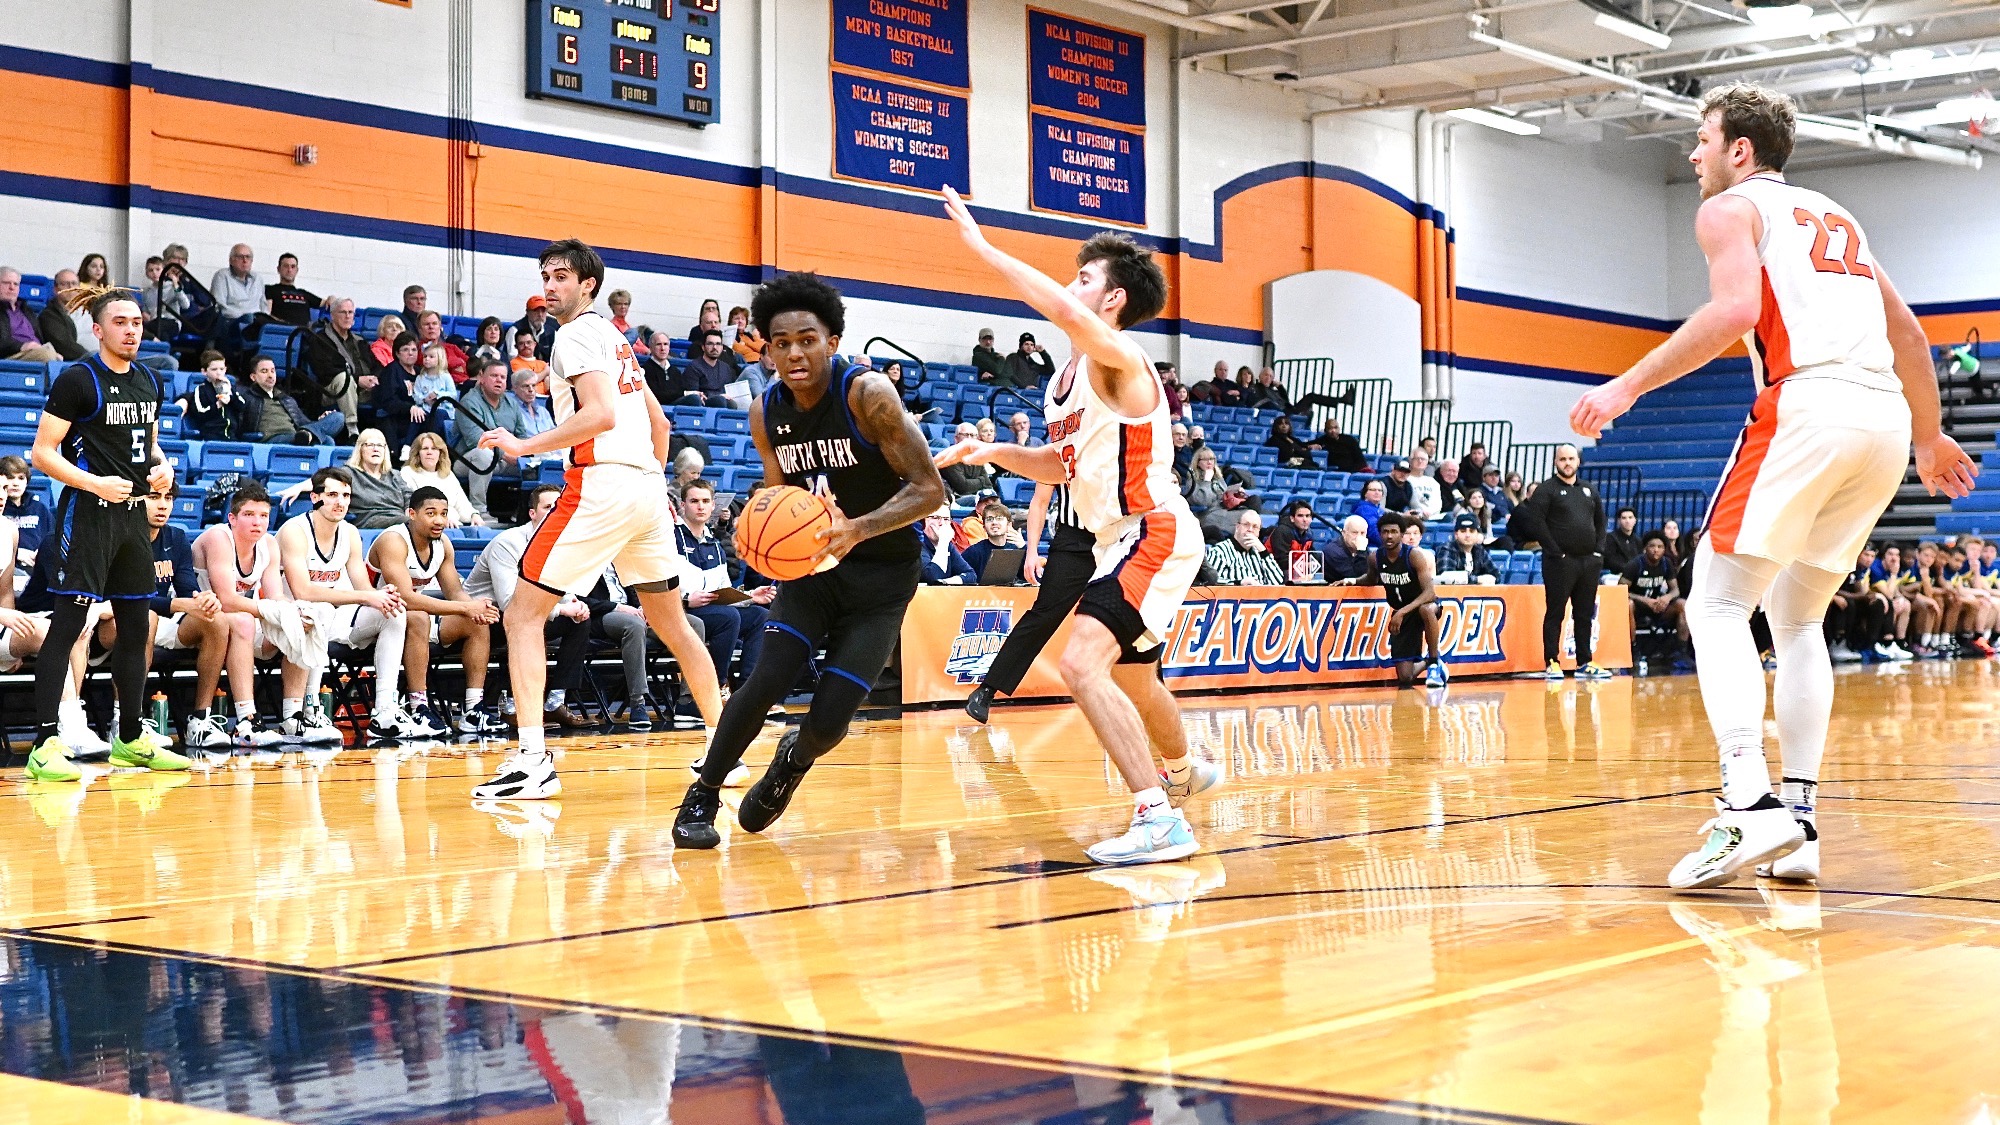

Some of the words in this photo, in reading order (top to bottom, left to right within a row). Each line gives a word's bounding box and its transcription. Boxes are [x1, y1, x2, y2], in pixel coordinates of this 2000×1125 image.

[553, 6, 581, 28] fouls
[869, 0, 932, 27] CHAMPIONS
[617, 19, 652, 42] player
[845, 15, 881, 38] MEN'S
[886, 25, 954, 55] BASKETBALL
[1045, 22, 1071, 42] NCAA
[1075, 30, 1114, 53] DIVISION
[1118, 41, 1129, 56] III
[564, 35, 577, 64] 6
[890, 48, 914, 68] 1957
[1061, 47, 1115, 72] CHAMPIONS
[556, 73, 578, 89] won
[694, 62, 707, 90] 9
[1047, 64, 1090, 87] WOMEN'S
[1094, 75, 1129, 95] SOCCER
[621, 85, 648, 101] game
[688, 98, 708, 113] won
[851, 84, 882, 105] NCAA
[887, 91, 933, 114] DIVISION
[937, 101, 950, 118] III
[1077, 91, 1101, 109] 2004
[870, 110, 933, 136] CHAMPIONS
[854, 129, 904, 153] WOMEN'S
[909, 139, 950, 160] SOCCER
[1047, 124, 1072, 143] NCAA
[1076, 130, 1116, 152] DIVISION
[1119, 139, 1130, 155] III
[889, 158, 916, 177] 2007
[1062, 148, 1116, 172] CHAMPIONS
[1049, 165, 1092, 187] WOMEN'S
[1095, 174, 1130, 194] SOCCER
[1793, 207, 1874, 280] 22
[615, 343, 643, 395] 23
[105, 402, 139, 425] NORTH
[131, 428, 146, 463] 5
[775, 441, 818, 474] NORTH
[816, 437, 859, 468] PARK
[1161, 600, 1333, 670] HEATON
[1329, 598, 1505, 668] THDER
